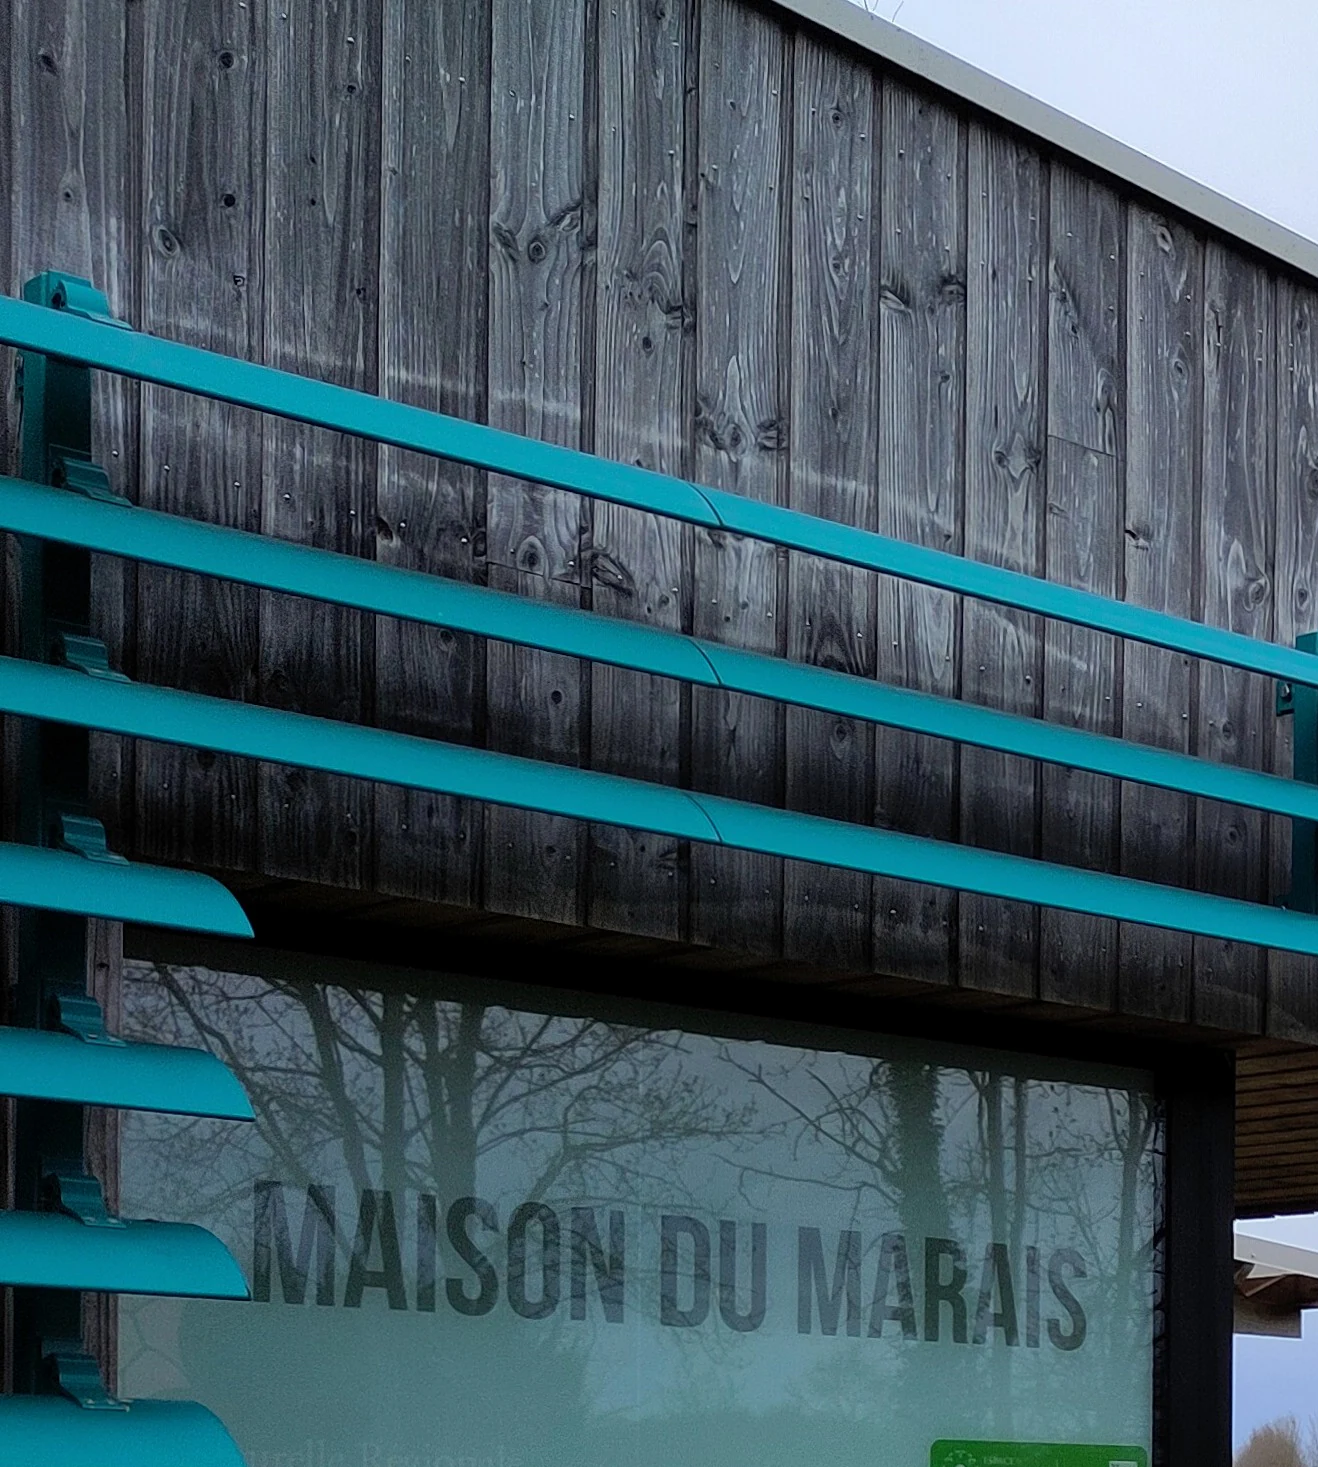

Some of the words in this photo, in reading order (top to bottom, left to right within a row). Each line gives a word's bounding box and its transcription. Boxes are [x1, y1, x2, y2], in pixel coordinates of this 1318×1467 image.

[253, 1180, 625, 1323] MAISON
[660, 1214, 767, 1333] DU
[797, 1225, 1087, 1352] MARAIS
